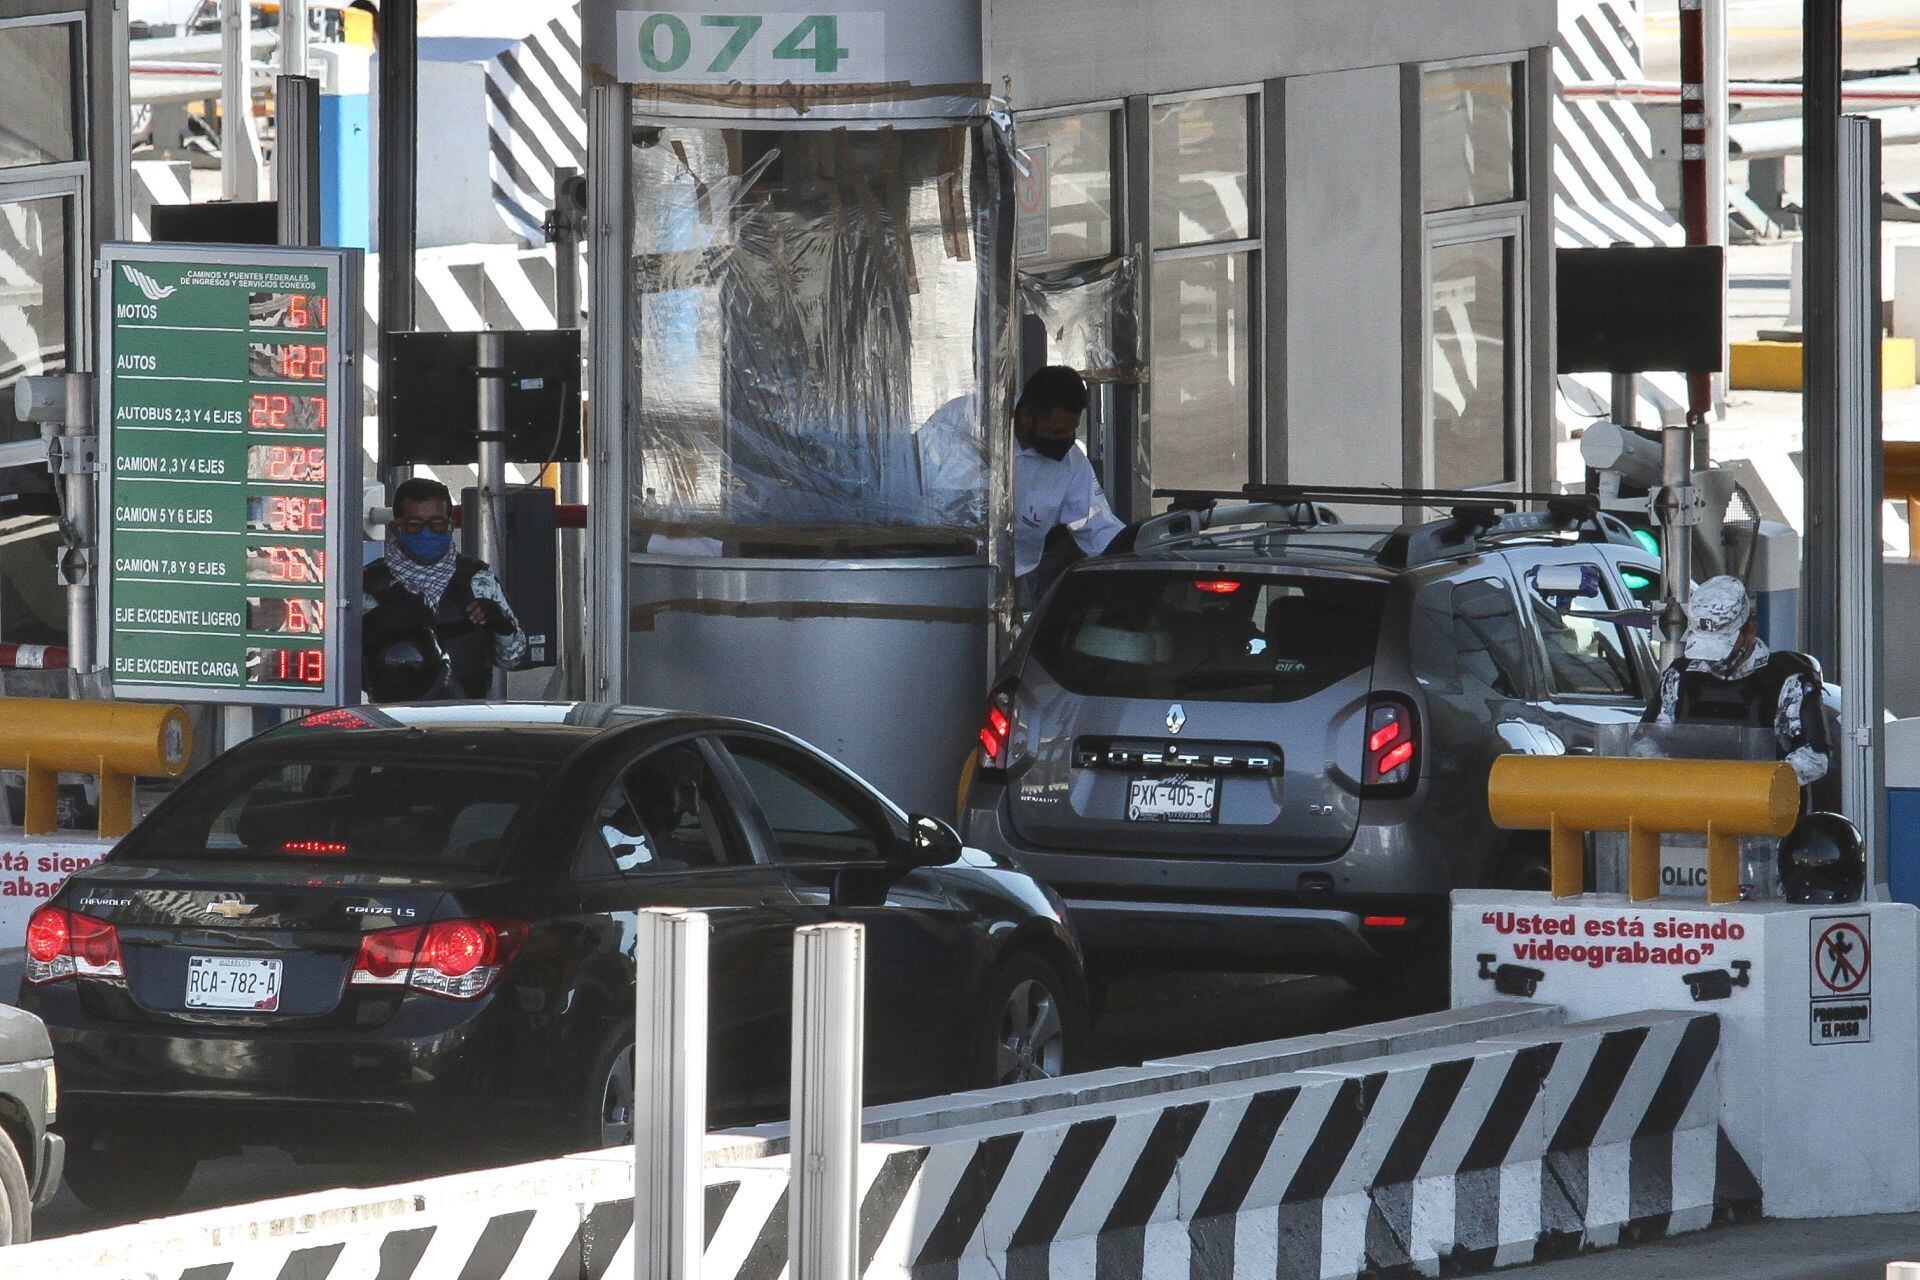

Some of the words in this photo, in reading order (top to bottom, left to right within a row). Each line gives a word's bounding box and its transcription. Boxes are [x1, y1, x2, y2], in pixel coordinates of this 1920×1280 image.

[638, 13, 849, 73] 074
[180, 277, 190, 285] DE
[192, 278, 230, 287] INGRESOS
[239, 279, 278, 288] SERVICIOS
[279, 281, 316, 290] CONEXOS
[187, 270, 221, 279] CAMINOS
[223, 272, 228, 280] Y
[229, 272, 263, 281] PUENTES
[265, 273, 309, 282] FEDERALES
[117, 304, 157, 319] MOTOS
[290, 294, 327, 327] 61
[117, 354, 156, 370] AUTOS
[283, 345, 325, 379] 122
[117, 406, 172, 421] AUTOBUS
[175, 408, 191, 424] 2,3
[193, 409, 201, 422] Y
[203, 410, 211, 423] 4
[213, 410, 242, 424] EJES
[116, 456, 158, 472] CAMION
[180, 459, 188, 472] Y
[189, 459, 196, 473] 4
[198, 459, 225, 474] EJES
[116, 506, 157, 522] CAMION
[159, 508, 167, 522] 5
[168, 508, 176, 522] Y
[177, 509, 184, 523] 6
[187, 509, 213, 524] EJES
[115, 558, 159, 573] CAMION
[162, 559, 177, 575] 7,8
[179, 560, 187, 573] Y
[189, 561, 196, 574] 9
[198, 561, 226, 575] EJES
[115, 607, 135, 623] EJE
[137, 609, 199, 625] EXCEDENTE
[201, 611, 241, 627] LIGERO
[115, 658, 135, 673] EJE
[136, 658, 199, 675] EXCEDENTE
[201, 661, 239, 677] CARGA
[279, 650, 324, 682] 113
[1130, 784, 1214, 808] PXK-405-C
[80, 897, 131, 906] CHEVROLET
[345, 906, 393, 915] CRUZE
[396, 907, 415, 917] LS
[1482, 912, 1575, 936] “Usted
[1584, 916, 1644, 938] está
[1653, 917, 1745, 940] siendo
[1513, 938, 1715, 968] videograbado”
[190, 970, 276, 994] RCA-782-A
[1821, 1024, 1832, 1038] EL
[1833, 1022, 1860, 1037] PASO
